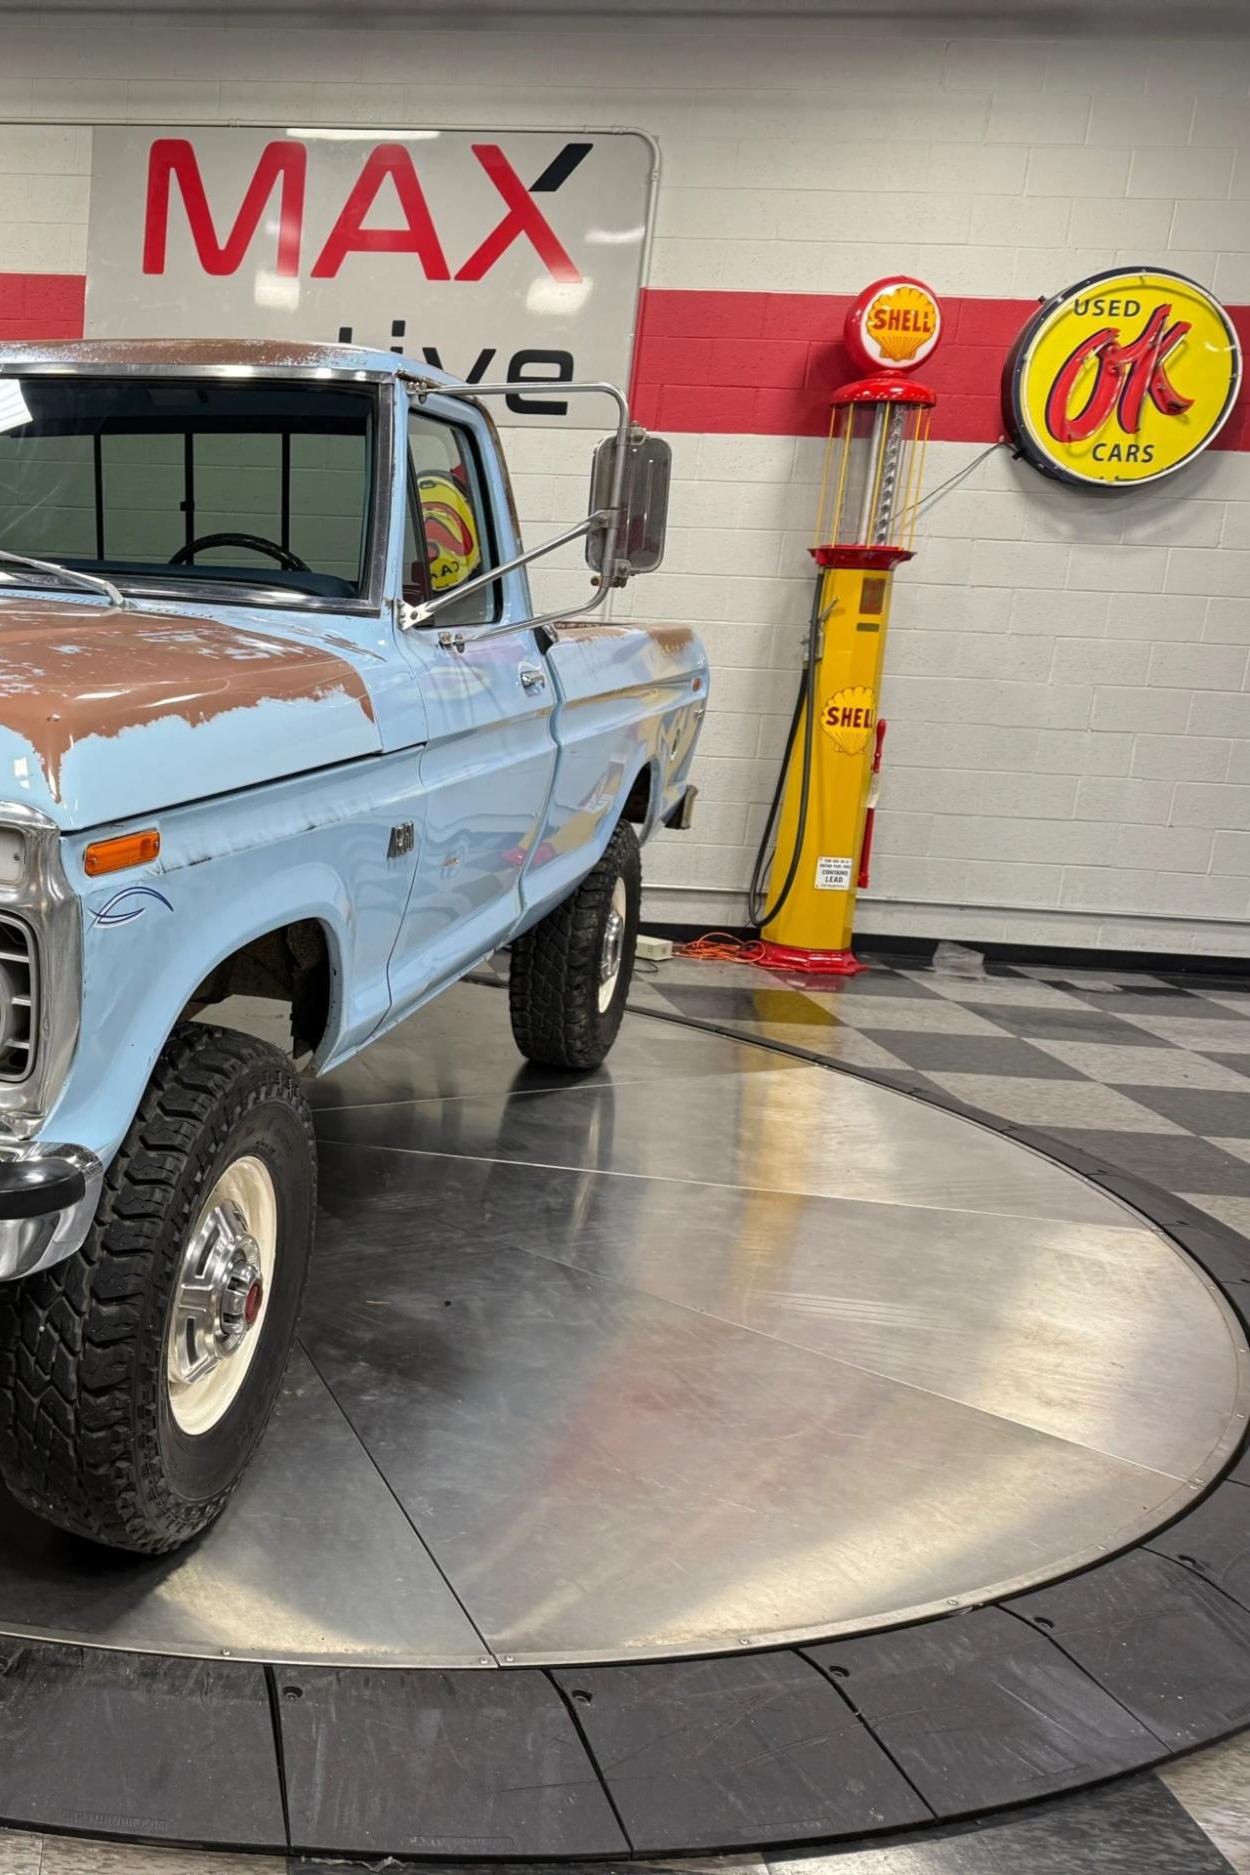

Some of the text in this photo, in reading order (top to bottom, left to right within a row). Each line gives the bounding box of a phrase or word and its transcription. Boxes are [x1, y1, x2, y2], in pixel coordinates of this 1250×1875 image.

[143, 138, 594, 283] MAX
[1073, 299, 1141, 317] USED
[874, 308, 931, 334] SHELL
[1045, 303, 1195, 443] OK
[1092, 443, 1154, 463] CARS
[825, 706, 872, 728] SHEL
